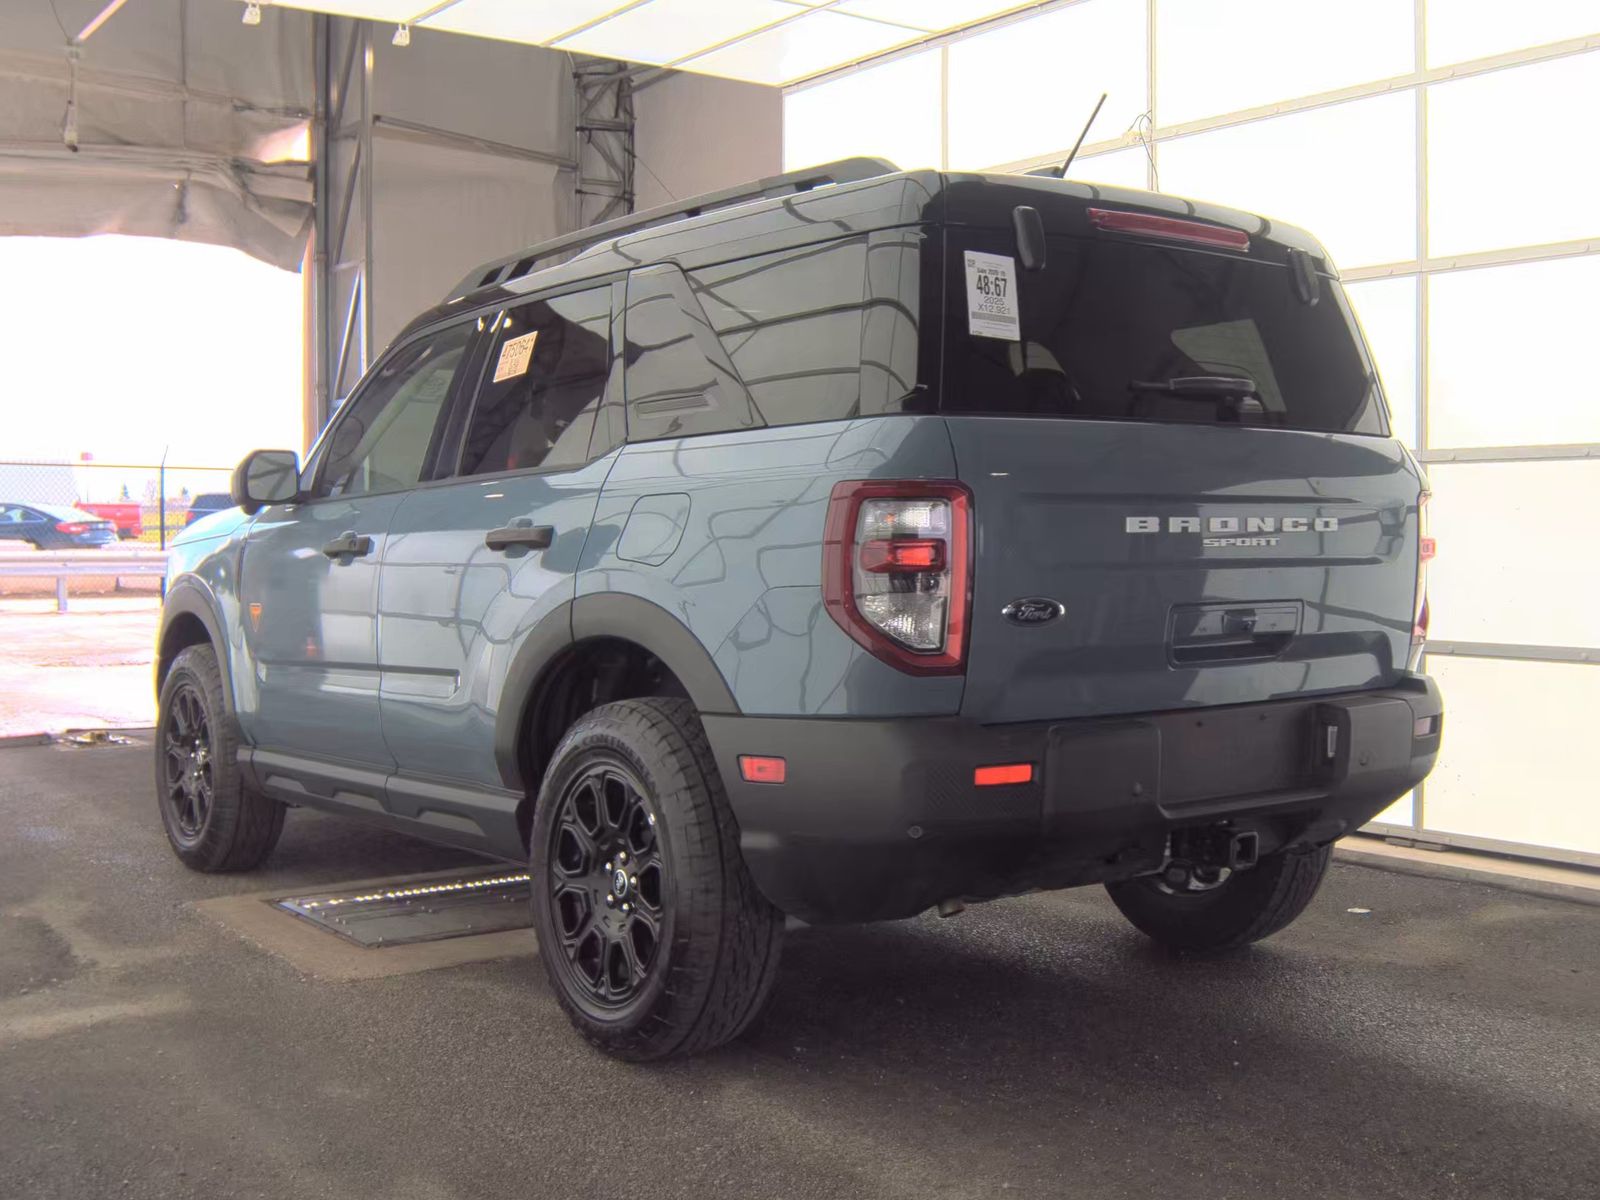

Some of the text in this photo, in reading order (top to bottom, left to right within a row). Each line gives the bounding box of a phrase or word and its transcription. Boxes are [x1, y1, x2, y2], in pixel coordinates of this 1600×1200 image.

[976, 274, 1007, 297] 48:67
[1126, 516, 1338, 533] BRONCO
[1203, 537, 1280, 547] SPORT
[1018, 603, 1053, 620] Ford
